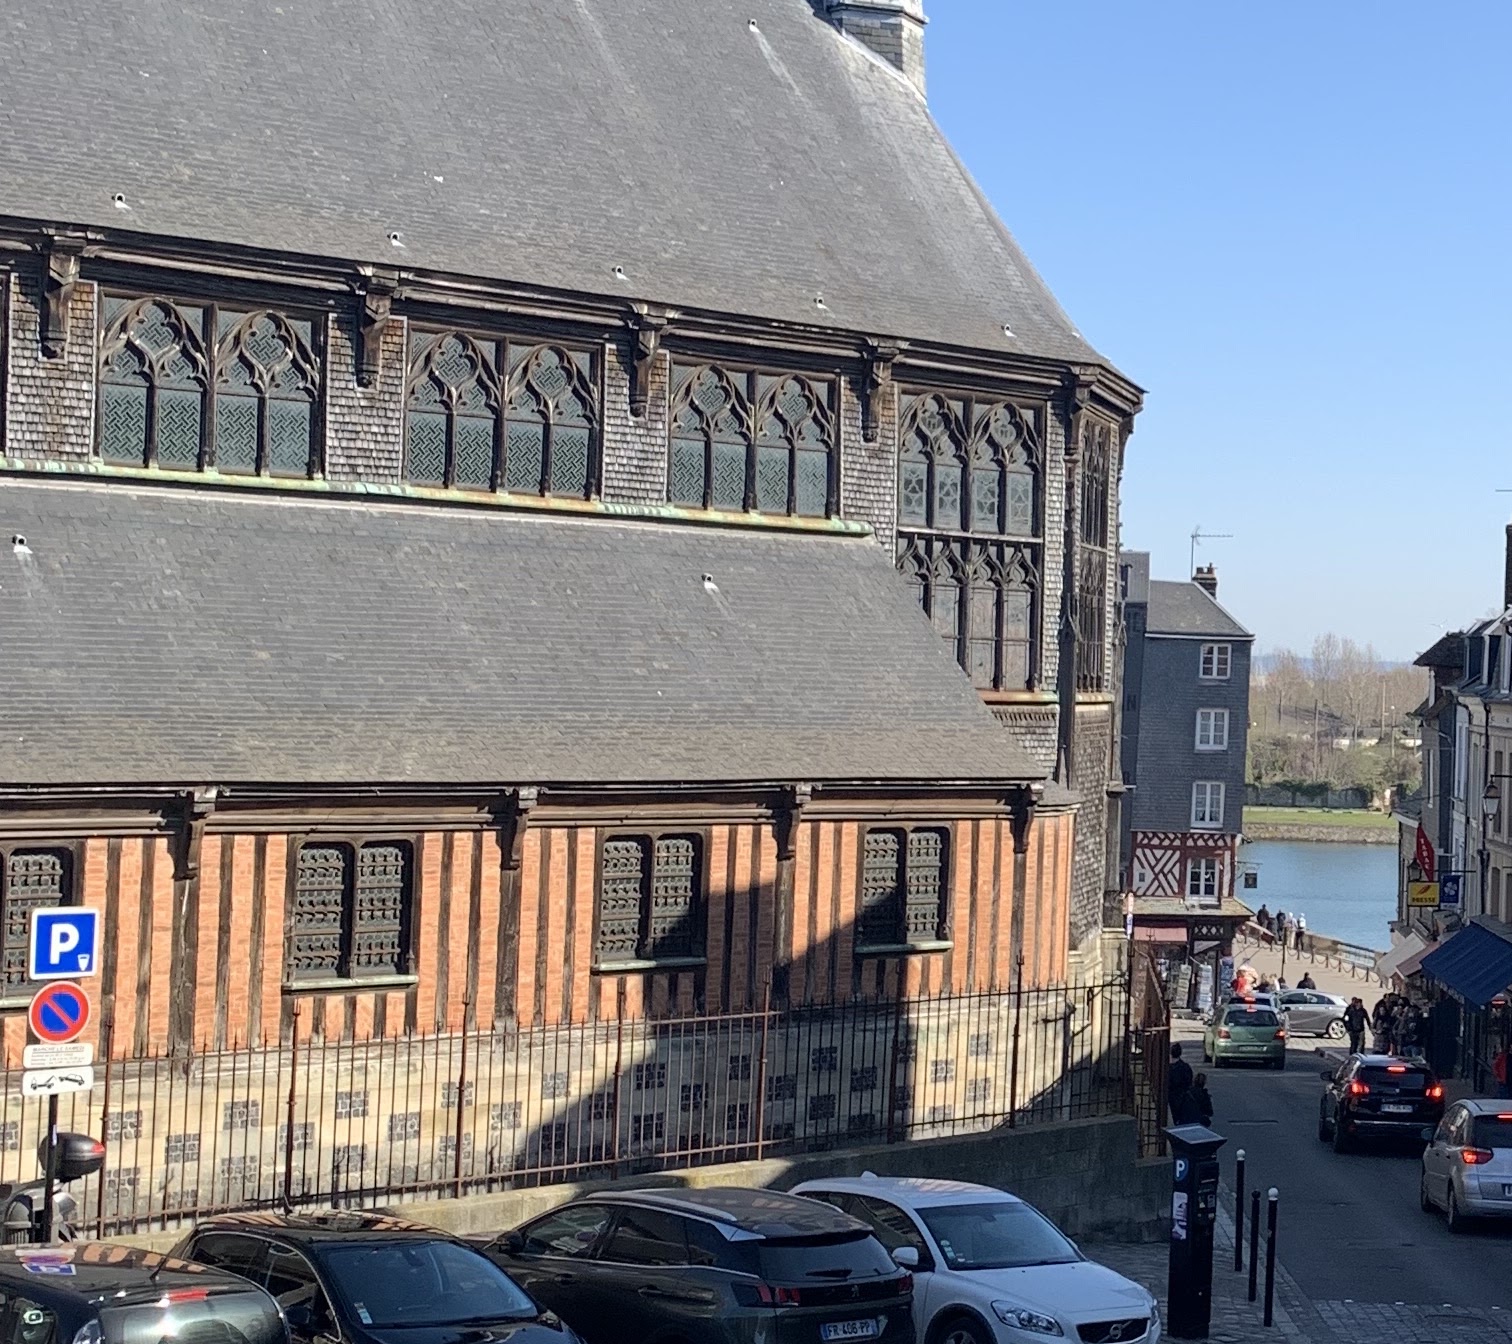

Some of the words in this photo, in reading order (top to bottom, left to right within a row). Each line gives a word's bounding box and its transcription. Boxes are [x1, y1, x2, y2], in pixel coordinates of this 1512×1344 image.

[1420, 837, 1430, 870] TABAC
[1411, 896, 1436, 904] PRESSE
[49, 923, 80, 965] P
[1175, 1159, 1186, 1178] P
